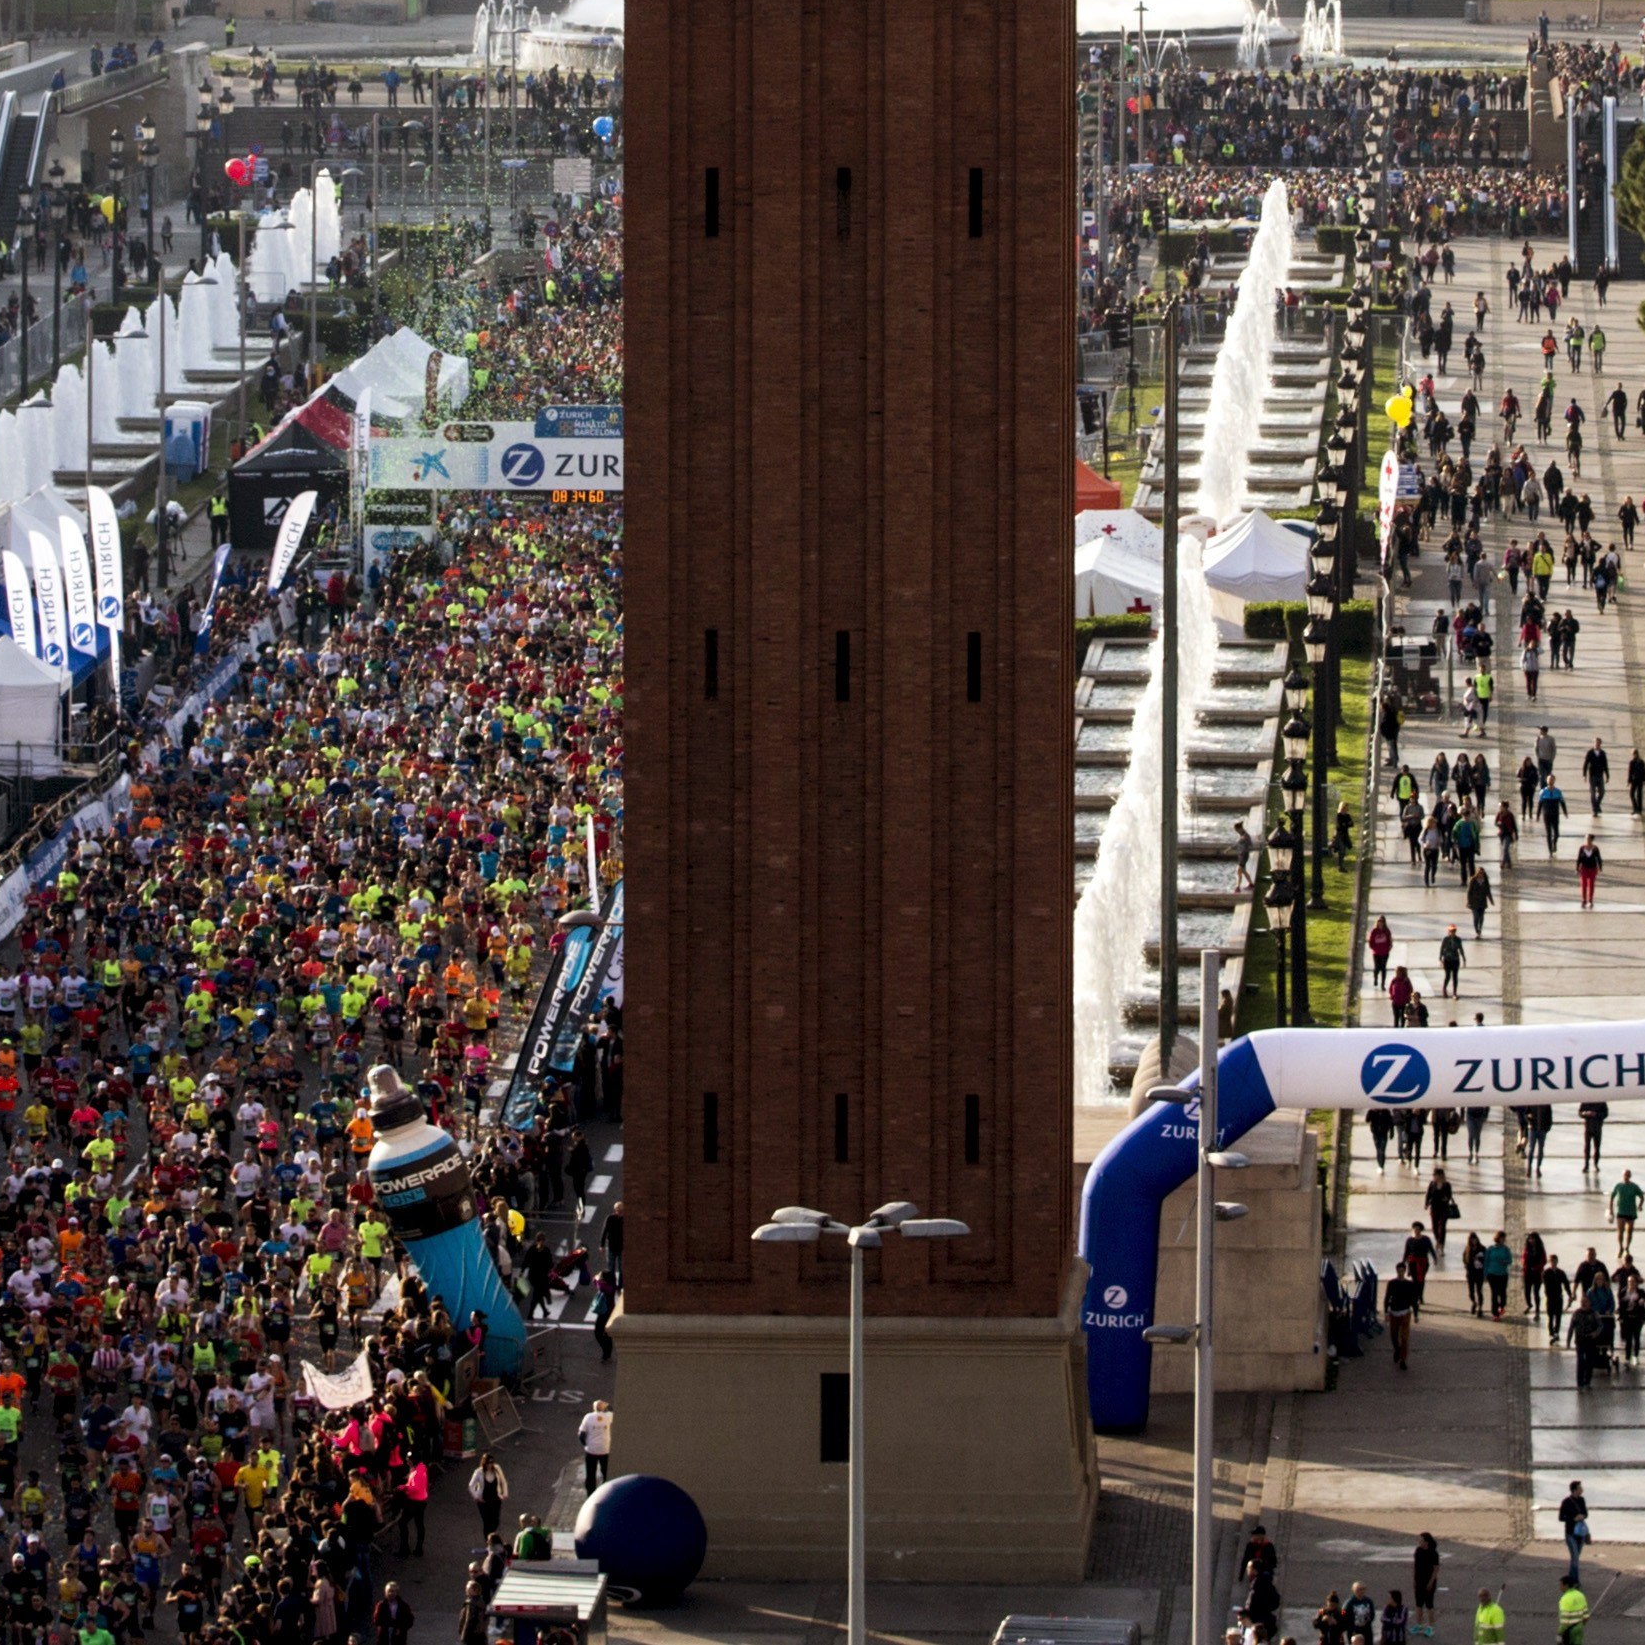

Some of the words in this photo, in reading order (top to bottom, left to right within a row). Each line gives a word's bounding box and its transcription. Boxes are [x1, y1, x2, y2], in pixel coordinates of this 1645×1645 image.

[559, 411, 592, 419] ZURICH
[574, 428, 621, 436] BARCELONA
[555, 454, 621, 477] ZUR
[527, 939, 583, 1075] POWERADE
[1160, 1124, 1225, 1147] ZURH
[373, 1152, 463, 1194] POWERADE
[1085, 1311, 1145, 1328] ZURICH
